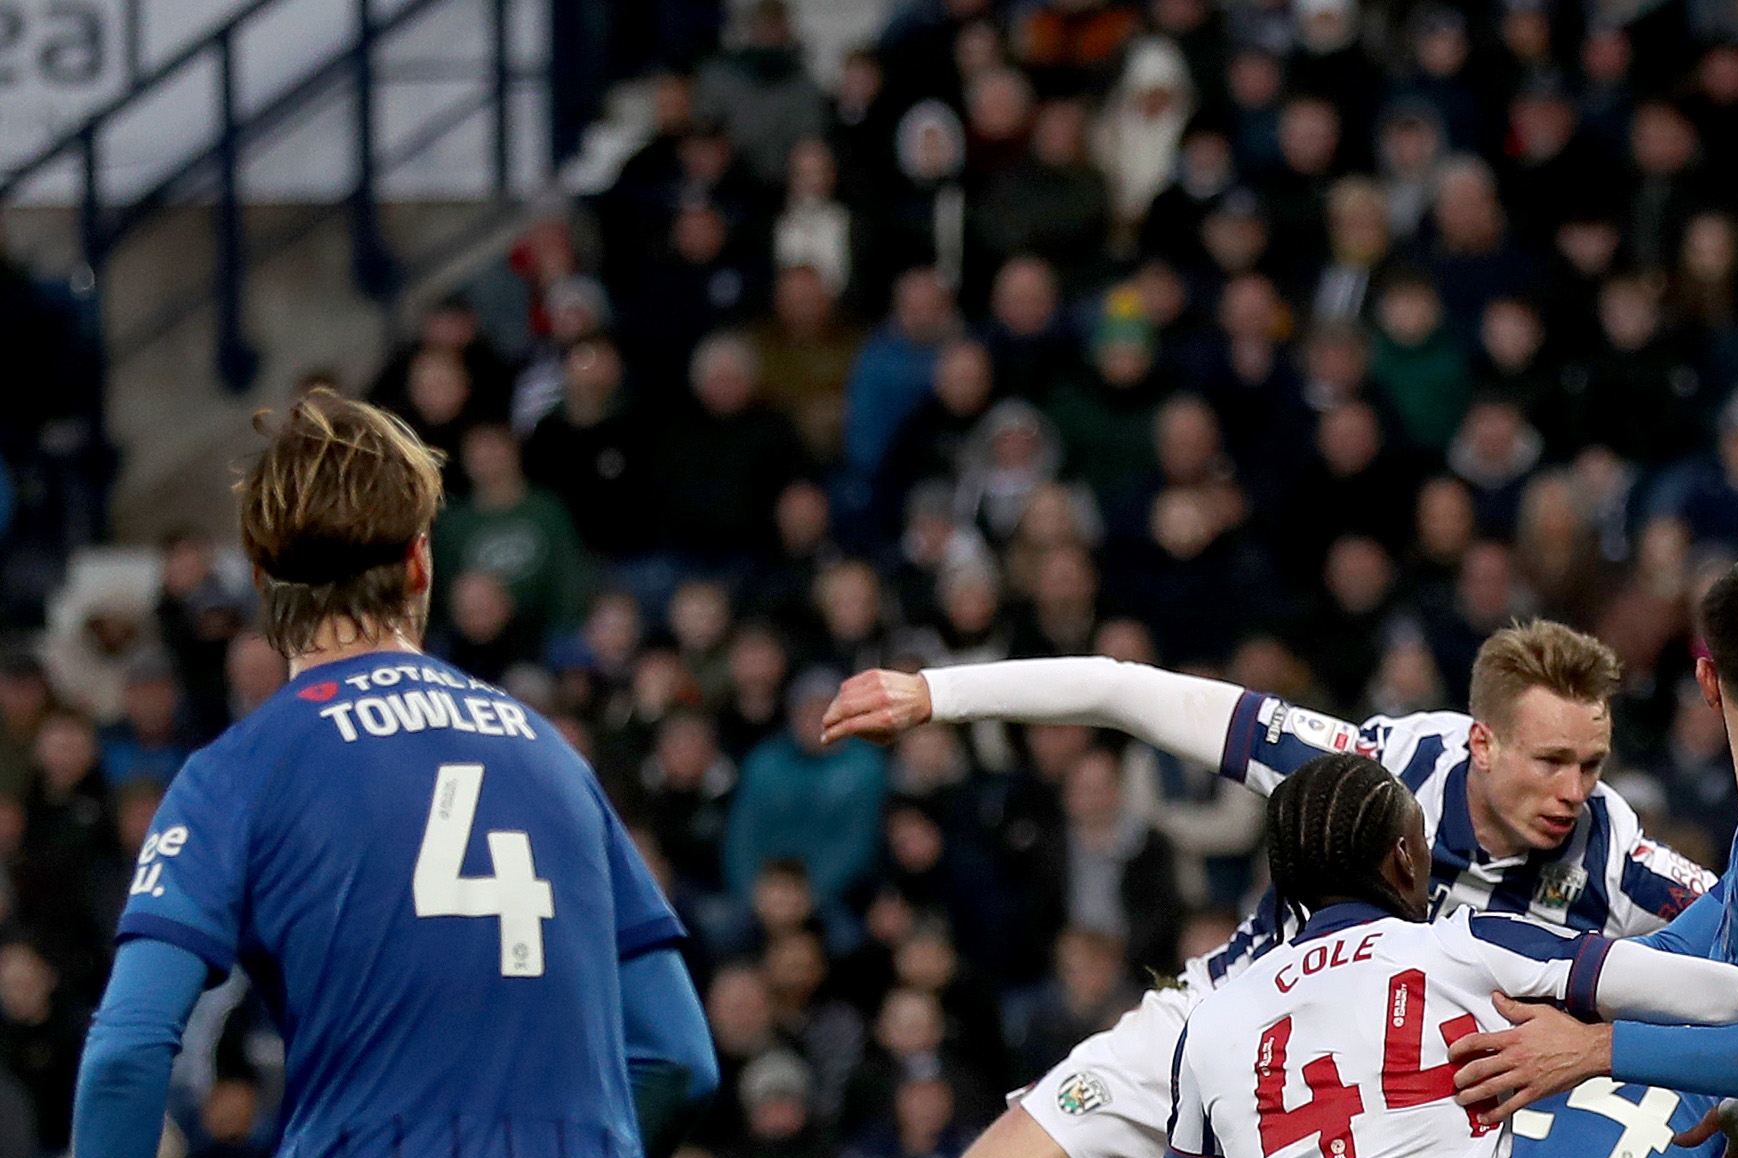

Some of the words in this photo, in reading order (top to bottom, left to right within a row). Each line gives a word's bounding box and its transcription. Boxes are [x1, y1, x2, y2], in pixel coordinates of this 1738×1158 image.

[345, 664, 466, 692] TOTAL
[319, 690, 538, 743] TOWLER
[412, 762, 556, 978] 4
[1273, 931, 1384, 993] COLE
